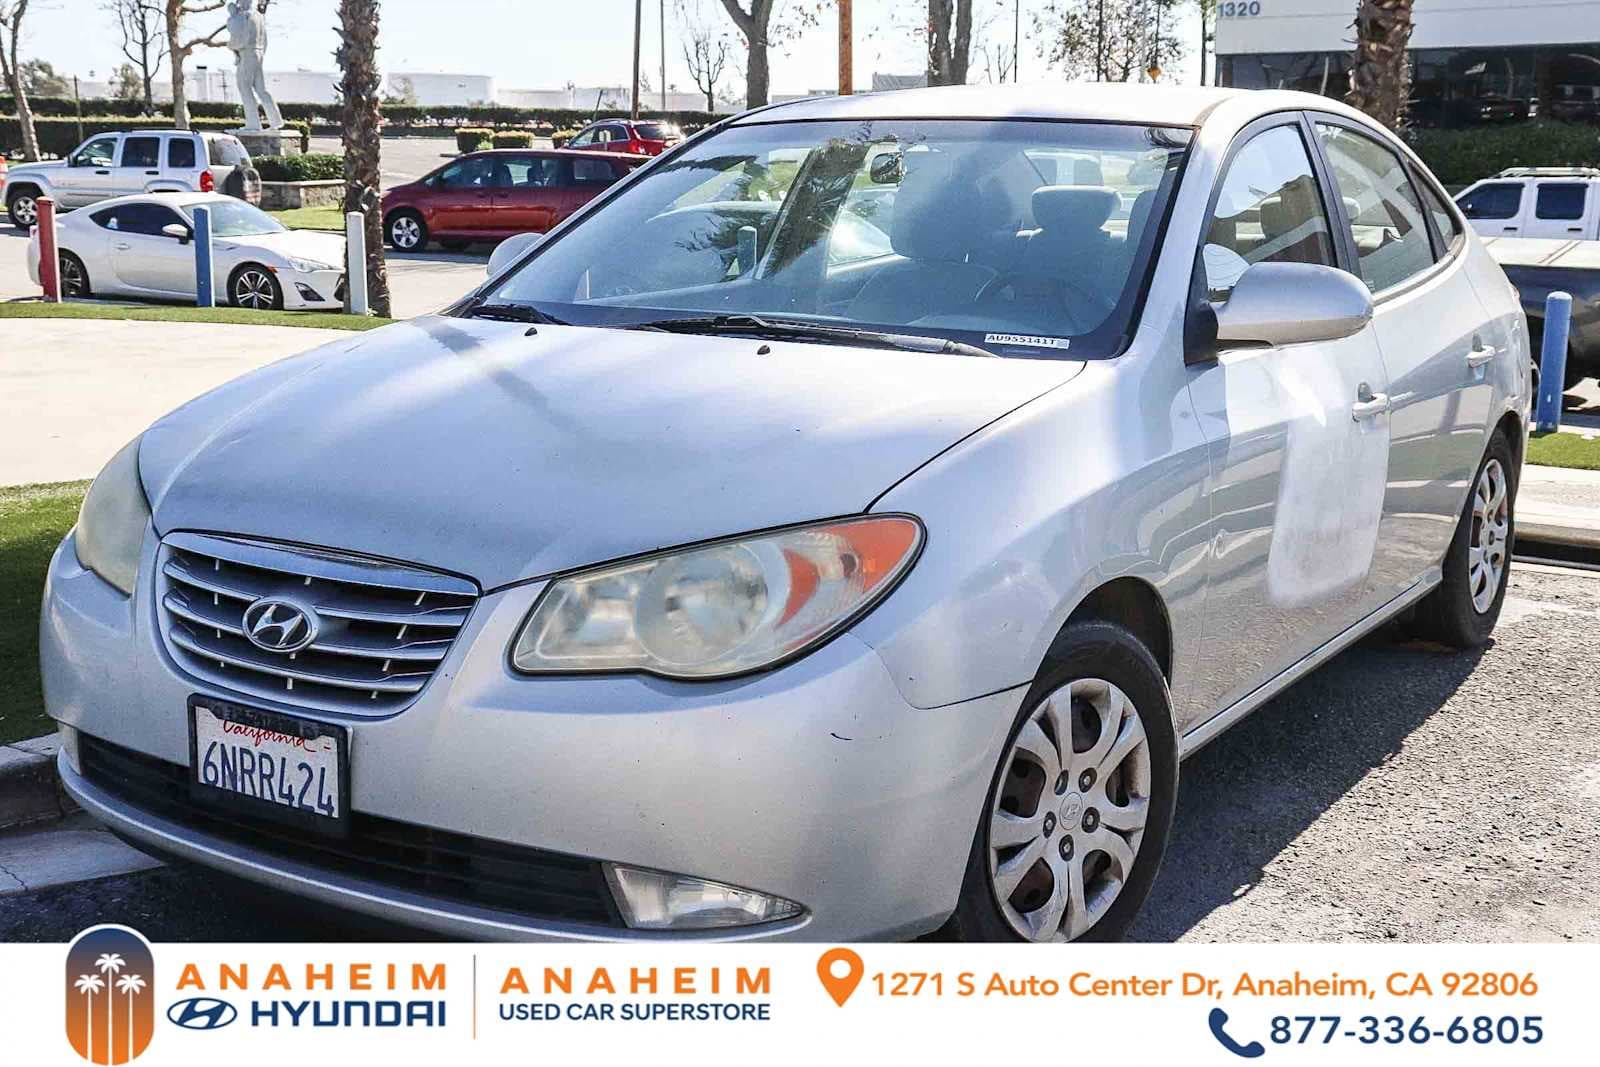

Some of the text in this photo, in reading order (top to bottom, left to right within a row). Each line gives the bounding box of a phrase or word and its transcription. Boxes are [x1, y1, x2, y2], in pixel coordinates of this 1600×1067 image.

[1217, 1, 1261, 17] 1320
[988, 335, 1057, 345] AU955141T
[203, 741, 335, 817] 6NRR424
